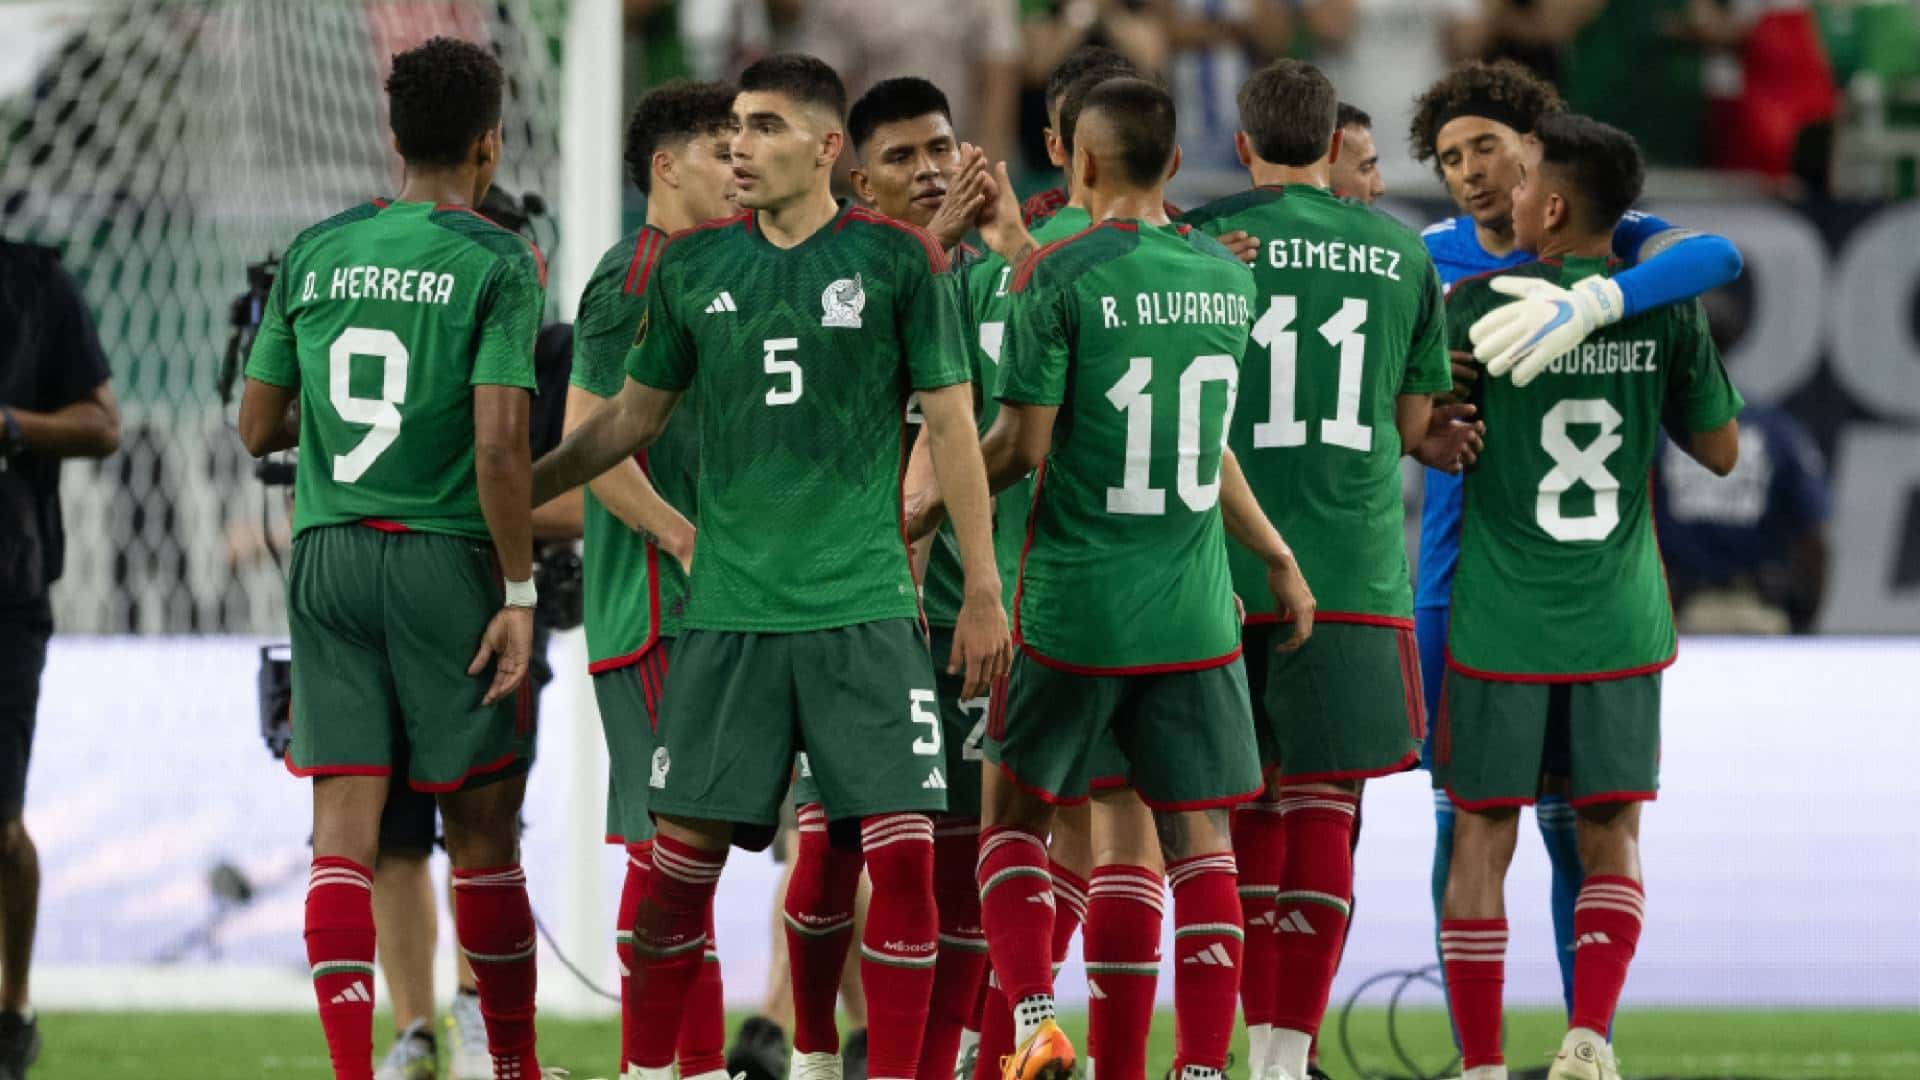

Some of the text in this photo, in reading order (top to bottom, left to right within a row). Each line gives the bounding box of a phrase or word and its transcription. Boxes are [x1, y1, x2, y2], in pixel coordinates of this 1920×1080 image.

[330, 265, 456, 304] HERRERA
[1101, 291, 1250, 329] R. ALVARADO
[329, 327, 409, 483] 9
[763, 337, 803, 406] 5
[1251, 295, 1373, 452] 11
[1105, 354, 1239, 515] 10
[1536, 399, 1623, 542] 8
[910, 688, 942, 755] 5
